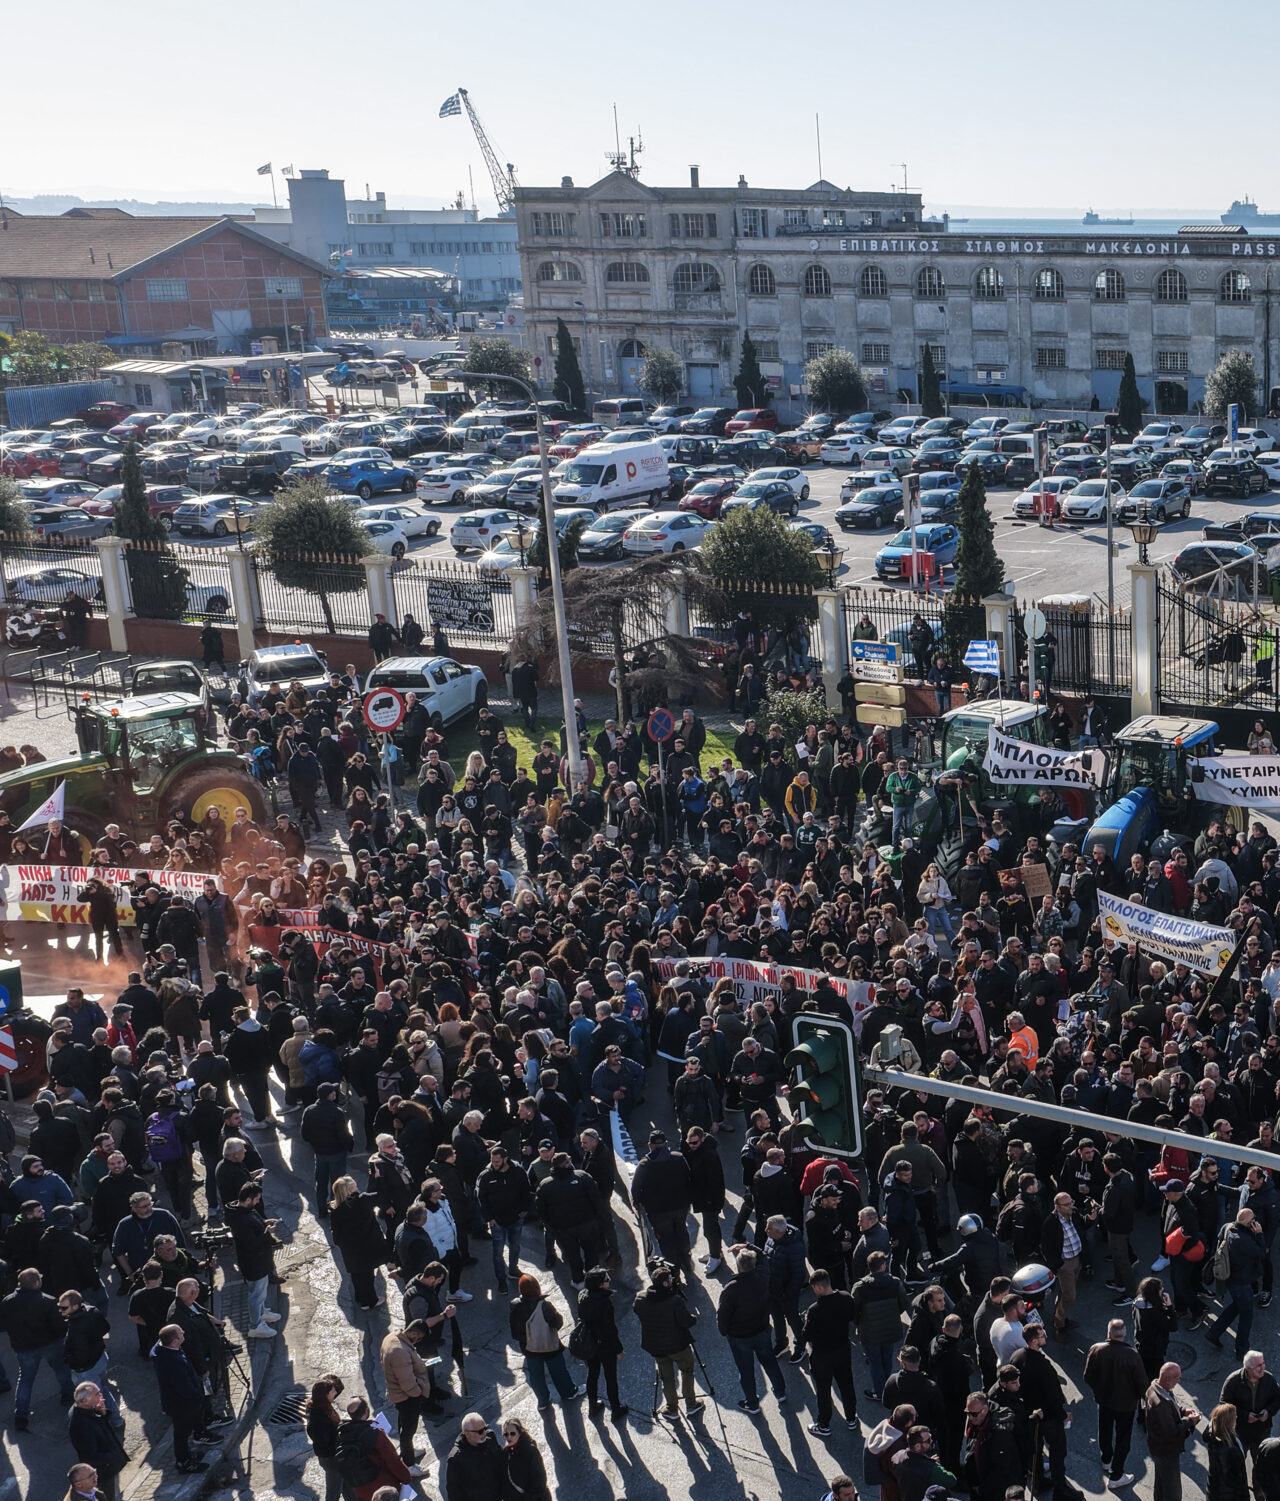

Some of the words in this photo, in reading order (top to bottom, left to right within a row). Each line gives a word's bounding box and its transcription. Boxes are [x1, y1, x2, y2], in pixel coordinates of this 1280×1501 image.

[840, 240, 939, 252] ΕΠΙΒΑΤΙΚΟΣ
[966, 241, 1044, 253] ΣΤΑΘΜΟΣ
[1086, 242, 1190, 254] ΜΑΚΕΔΟΝΙΑ
[994, 737, 1080, 767] ΜΠΛΟΚ
[18, 865, 52, 882] ΝΙΚΗ
[60, 866, 88, 882] ΣΤΟΝ
[63, 885, 70, 900] Η
[1099, 895, 1155, 924] ΣΥΛΛΟΓΟΣ
[1153, 917, 1235, 944] ΕΠΑΓΓΕΛΜΑΤΙΩΝ
